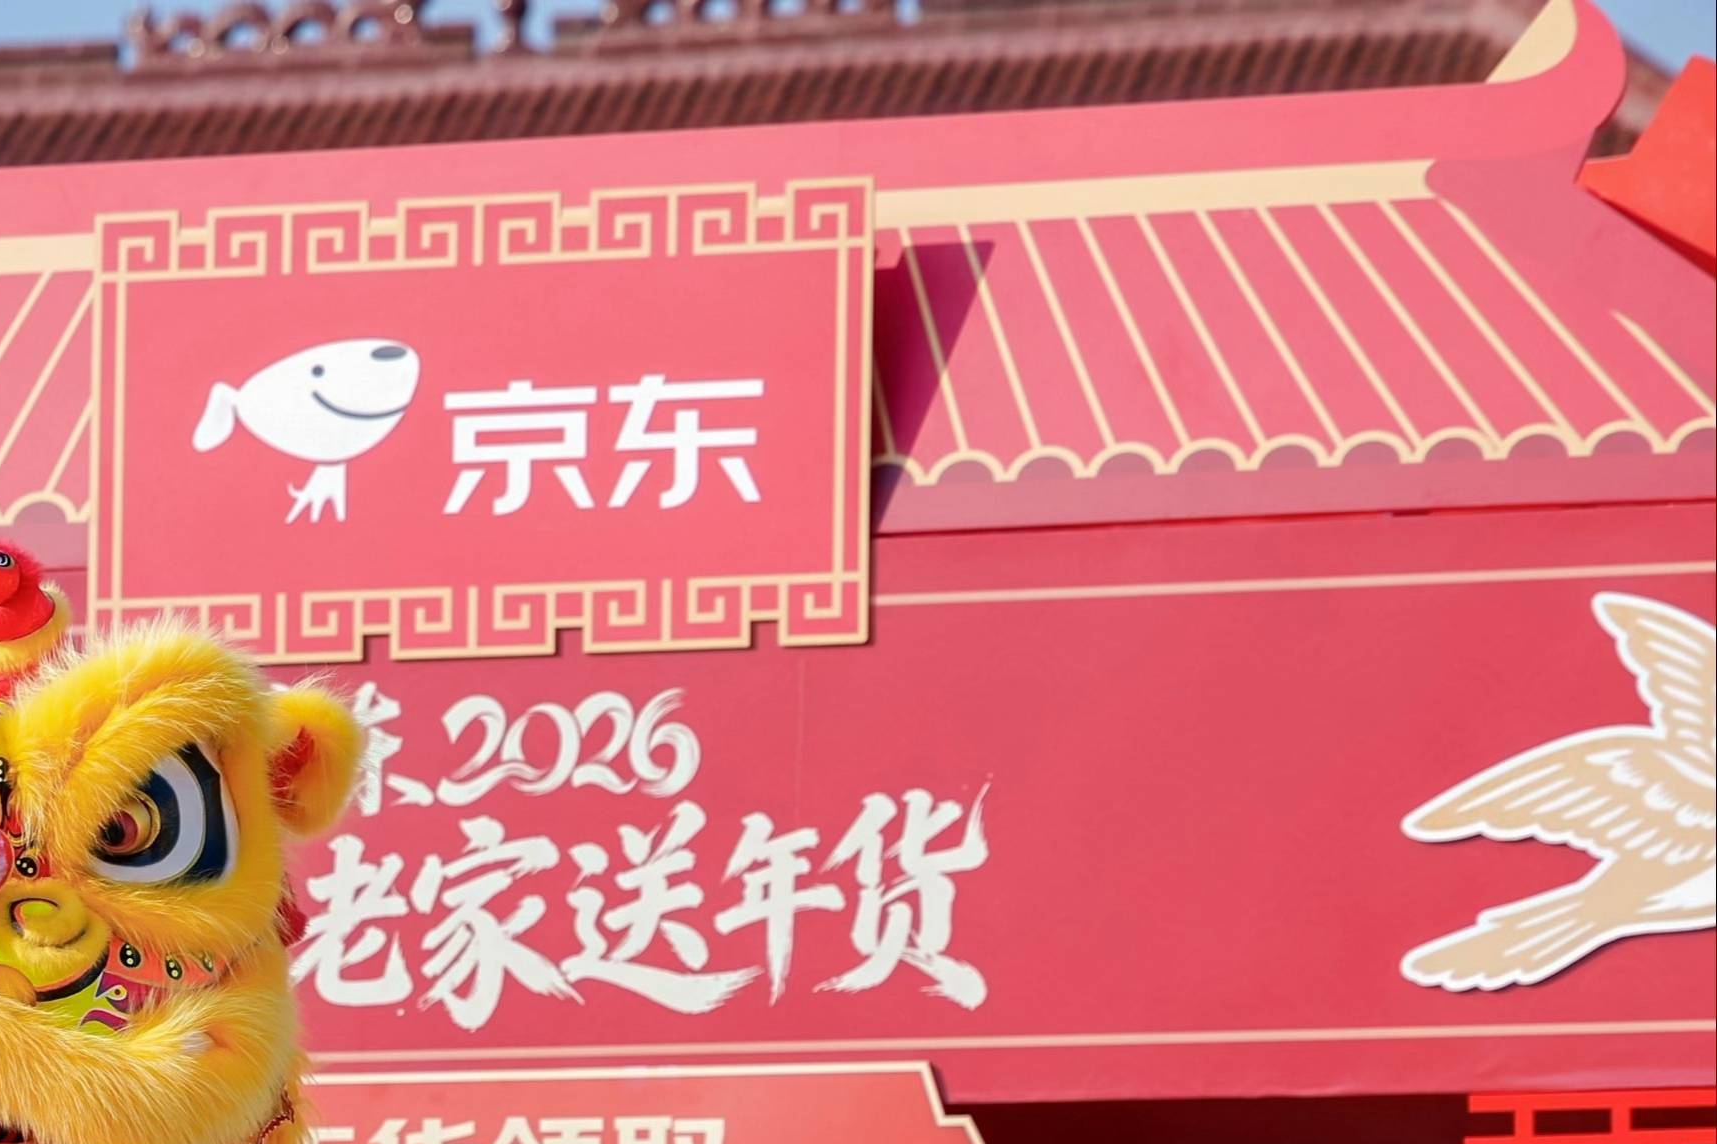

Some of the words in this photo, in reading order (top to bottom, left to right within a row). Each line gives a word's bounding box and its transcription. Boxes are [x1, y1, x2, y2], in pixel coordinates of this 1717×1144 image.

[443, 374, 765, 516] 京东
[289, 782, 990, 1029] 老家送年货
